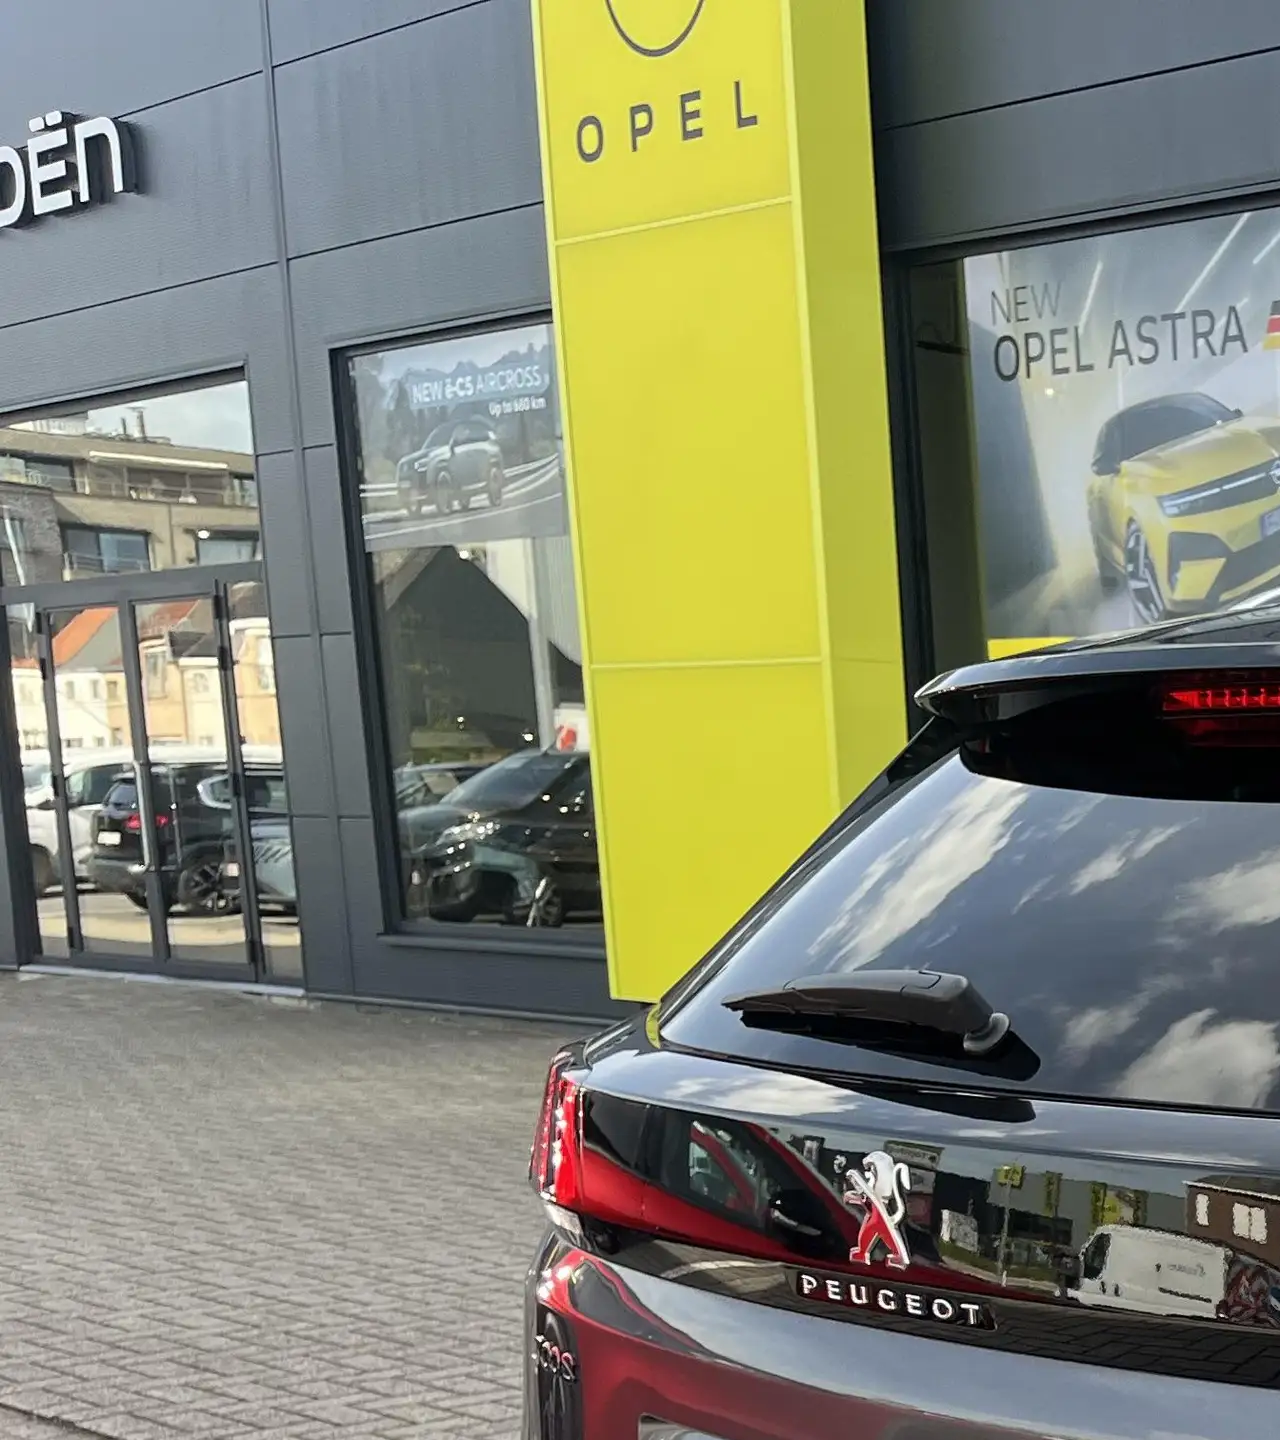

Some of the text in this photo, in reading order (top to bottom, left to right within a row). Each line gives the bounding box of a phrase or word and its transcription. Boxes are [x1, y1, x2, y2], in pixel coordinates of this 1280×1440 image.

[577, 80, 758, 163] OPEL
[991, 282, 1062, 326] NEW
[994, 305, 1249, 382] OPEL ASTRA
[411, 381, 443, 404] NEW
[475, 365, 541, 394] AIRCROSS
[801, 1275, 980, 1325] PEUGEOT
